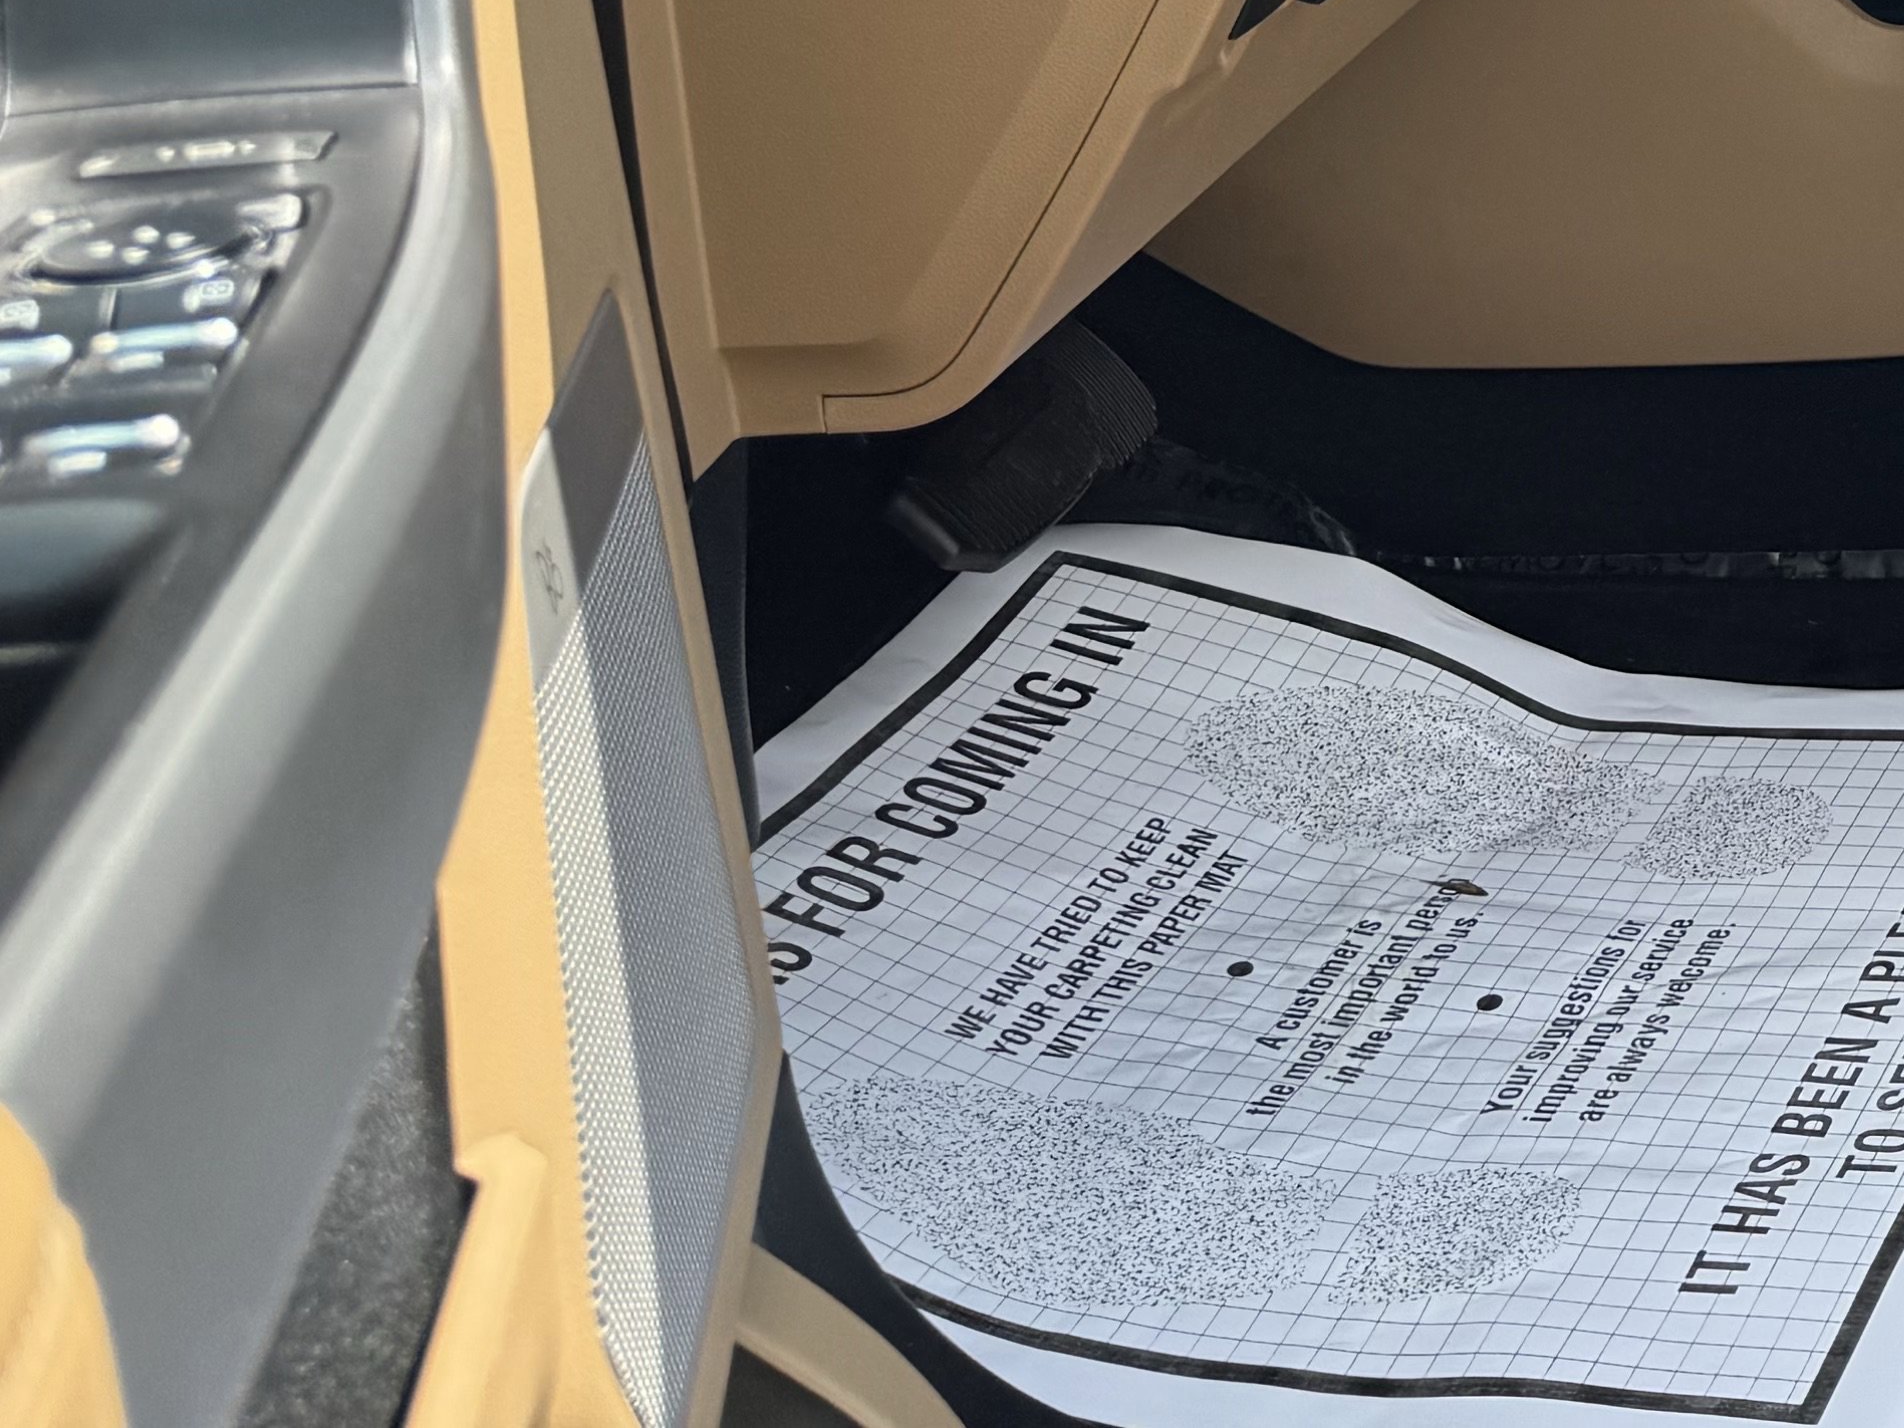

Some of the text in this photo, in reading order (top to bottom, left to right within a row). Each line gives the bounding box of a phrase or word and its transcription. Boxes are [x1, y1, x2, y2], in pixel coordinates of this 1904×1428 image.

[763, 836, 921, 938] FOR
[874, 671, 1099, 839] COMING
[1050, 605, 1151, 666] IN
[945, 817, 1172, 1040] WE HAVE TRIED TO KEEP
[985, 828, 1218, 1056] YOUR CARPETING CLEAN
[1040, 850, 1249, 1059] WITH THIS PAPER MAT
[1255, 919, 1382, 1050] A customer is
[1325, 912, 1485, 1084] in the world to us.
[1841, 997, 1900, 1024] A
[1246, 1084, 1295, 1116] the
[1283, 1031, 1341, 1080] most
[1320, 935, 1419, 1028] important
[1479, 919, 1647, 1115] Your suggestions for
[1522, 918, 1694, 1122] improving our service
[1578, 1088, 1620, 1122] are
[1606, 1013, 1671, 1083] always
[1770, 1036, 1880, 1138] BEEN
[1678, 1250, 1751, 1295] IT
[1710, 1153, 1811, 1235] HAS
